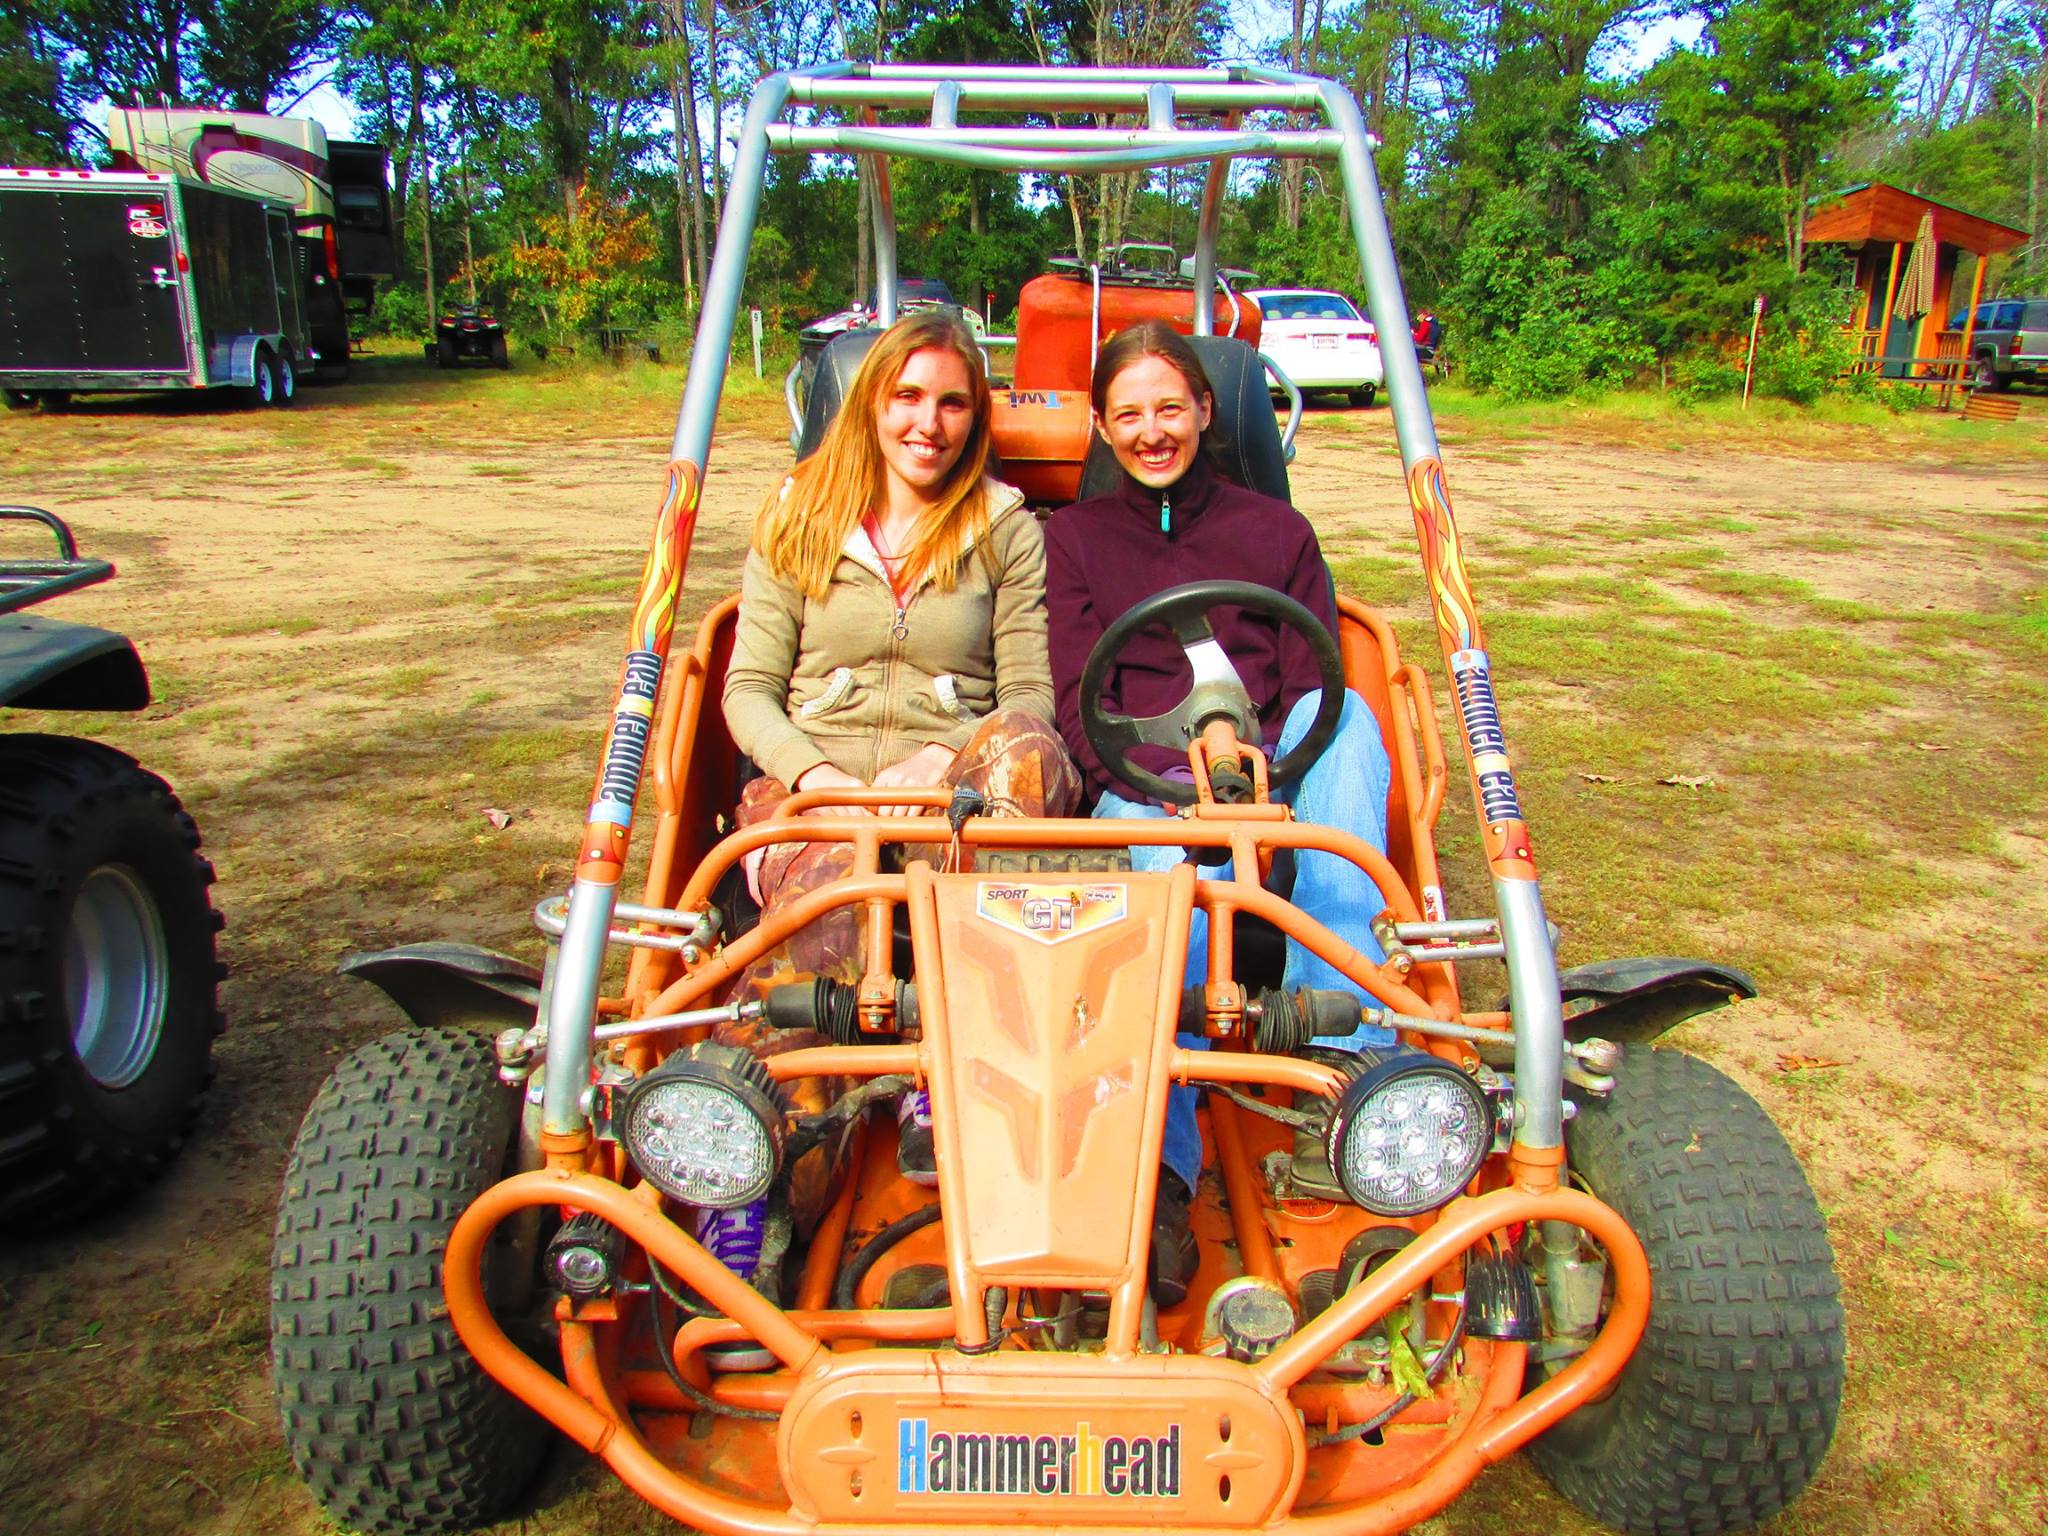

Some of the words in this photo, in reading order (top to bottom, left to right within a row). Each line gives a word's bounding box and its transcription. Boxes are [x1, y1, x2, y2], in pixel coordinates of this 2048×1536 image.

[986, 889, 1029, 901] SPORT
[1022, 898, 1077, 930] GT
[898, 1418, 1182, 1497] Hammerhead
